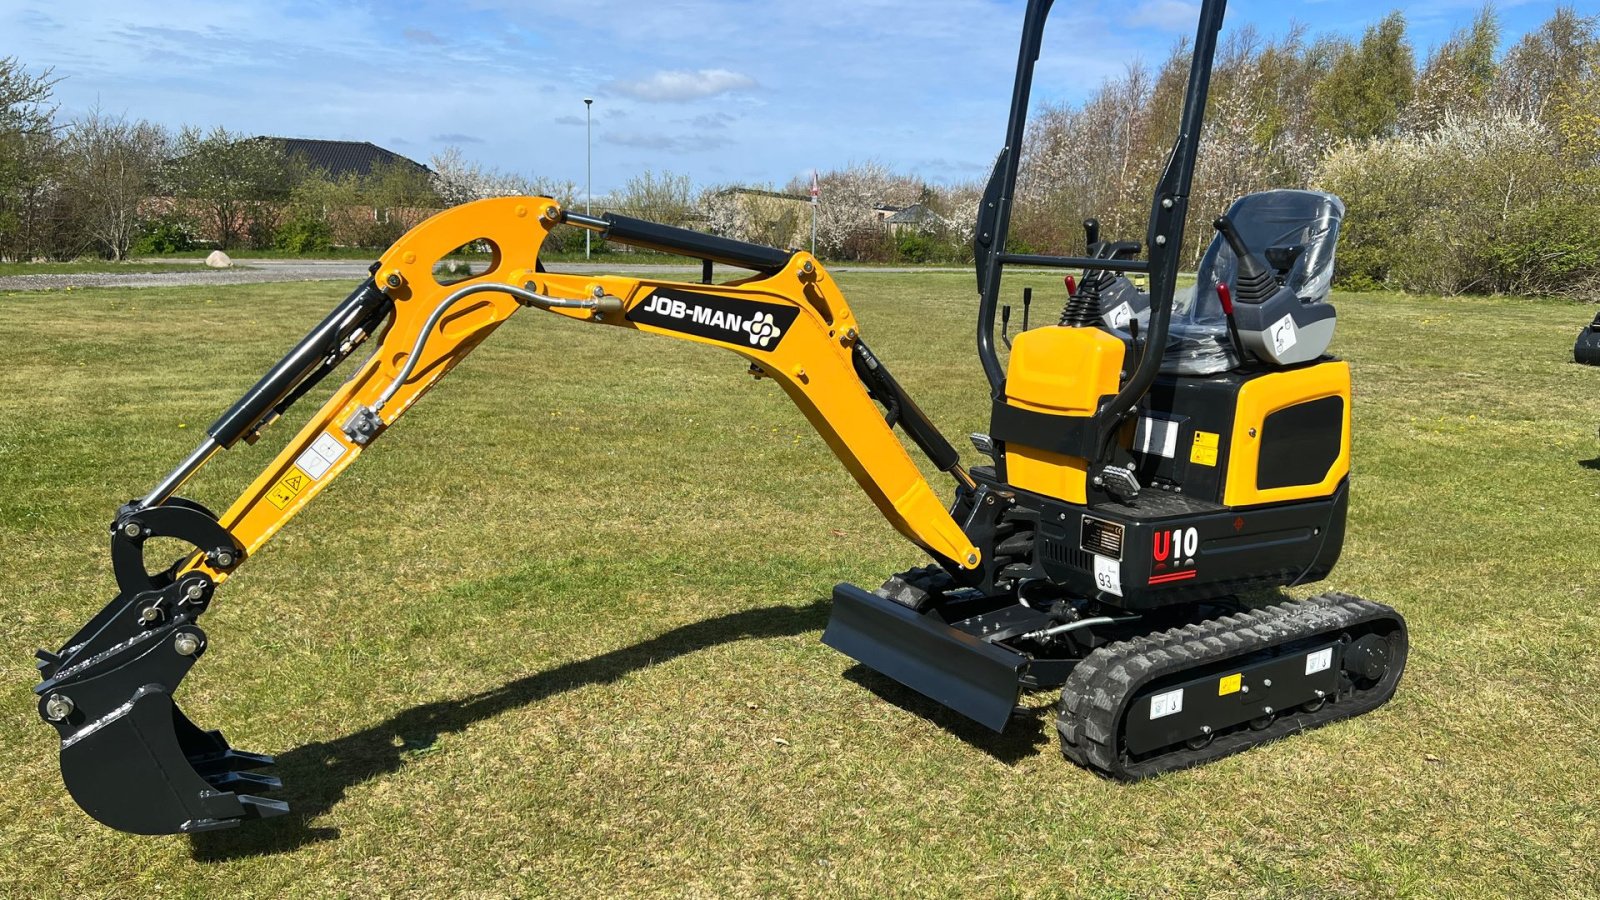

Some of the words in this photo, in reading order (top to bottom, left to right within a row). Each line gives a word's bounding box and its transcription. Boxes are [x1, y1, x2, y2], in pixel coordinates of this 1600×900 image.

[643, 295, 742, 332] JOB-MAN
[1153, 527, 1198, 561] U10
[1098, 572, 1112, 589] 93
